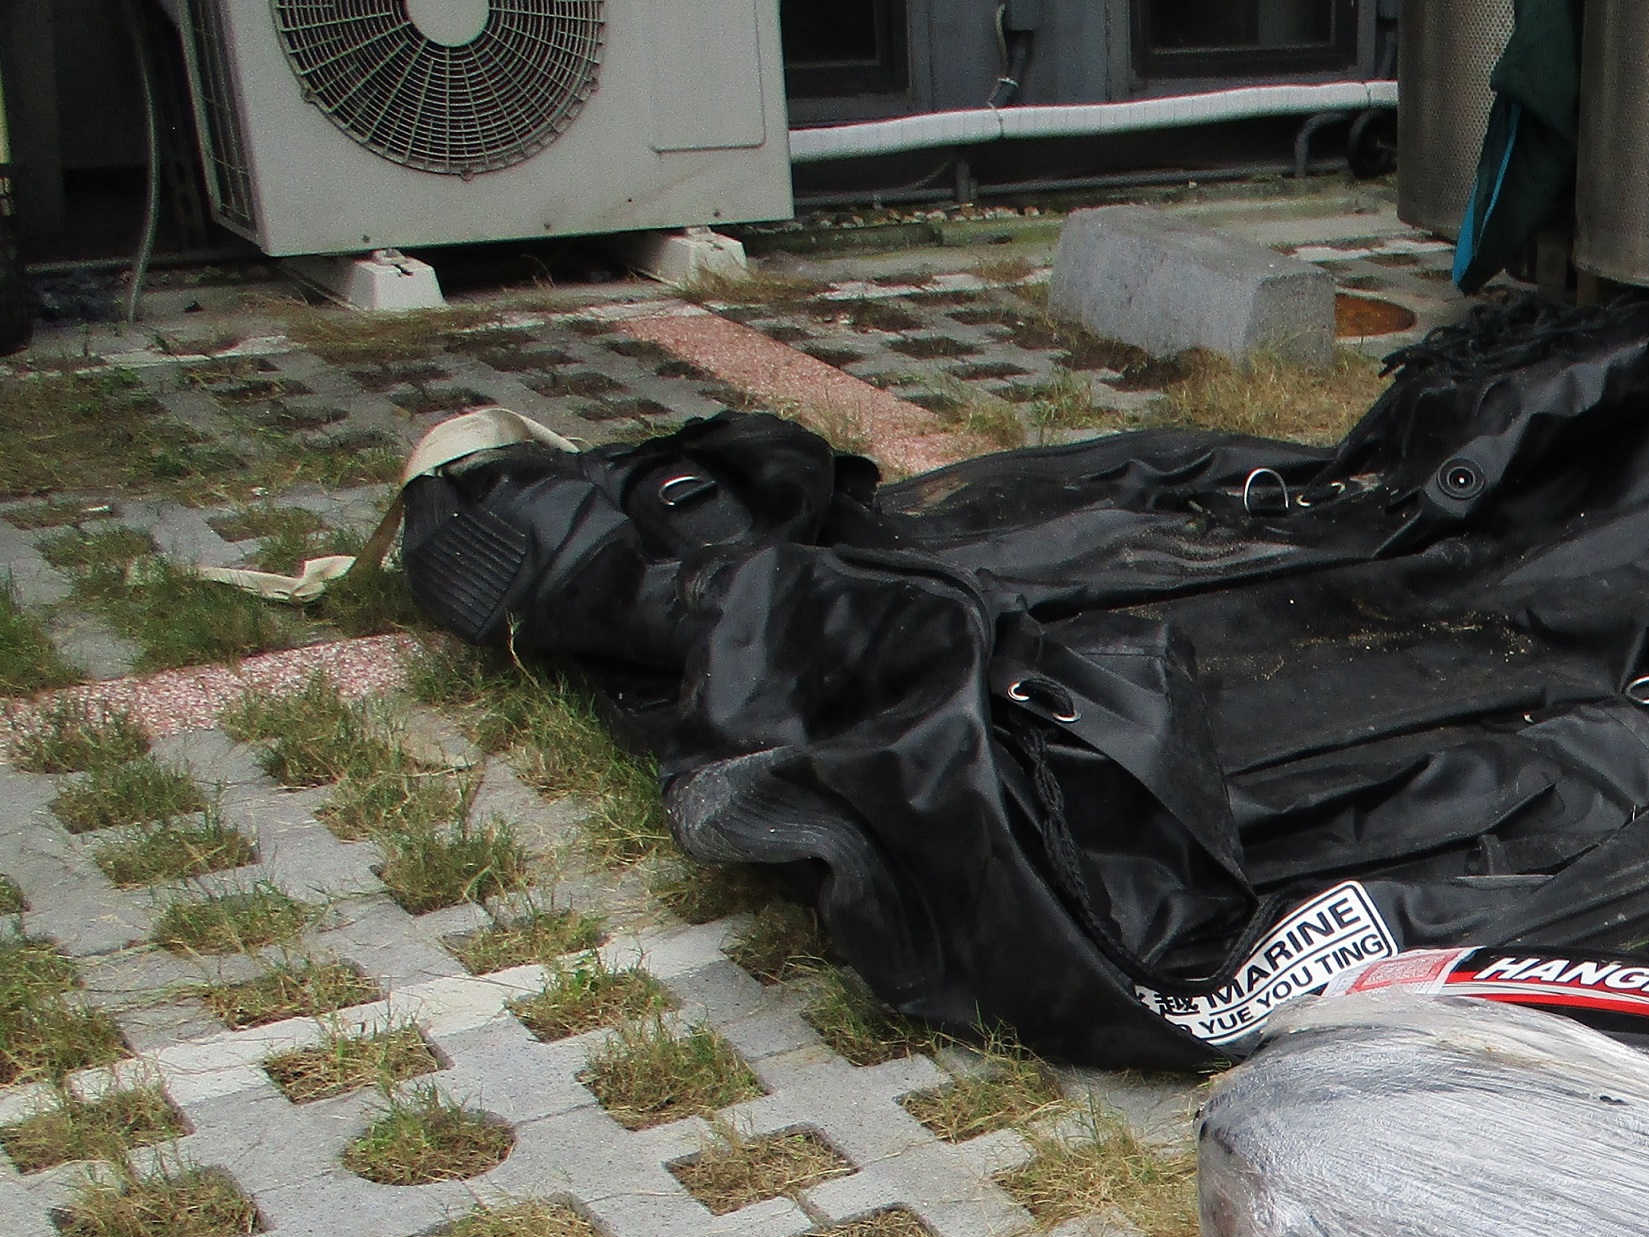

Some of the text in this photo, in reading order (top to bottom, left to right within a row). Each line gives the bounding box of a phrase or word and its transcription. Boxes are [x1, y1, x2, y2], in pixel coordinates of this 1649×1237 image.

[1198, 1005, 1255, 1034] YUE
[1257, 965, 1314, 1010] YOU
[1315, 933, 1385, 975] TING
[1203, 898, 1362, 1009] MARINE
